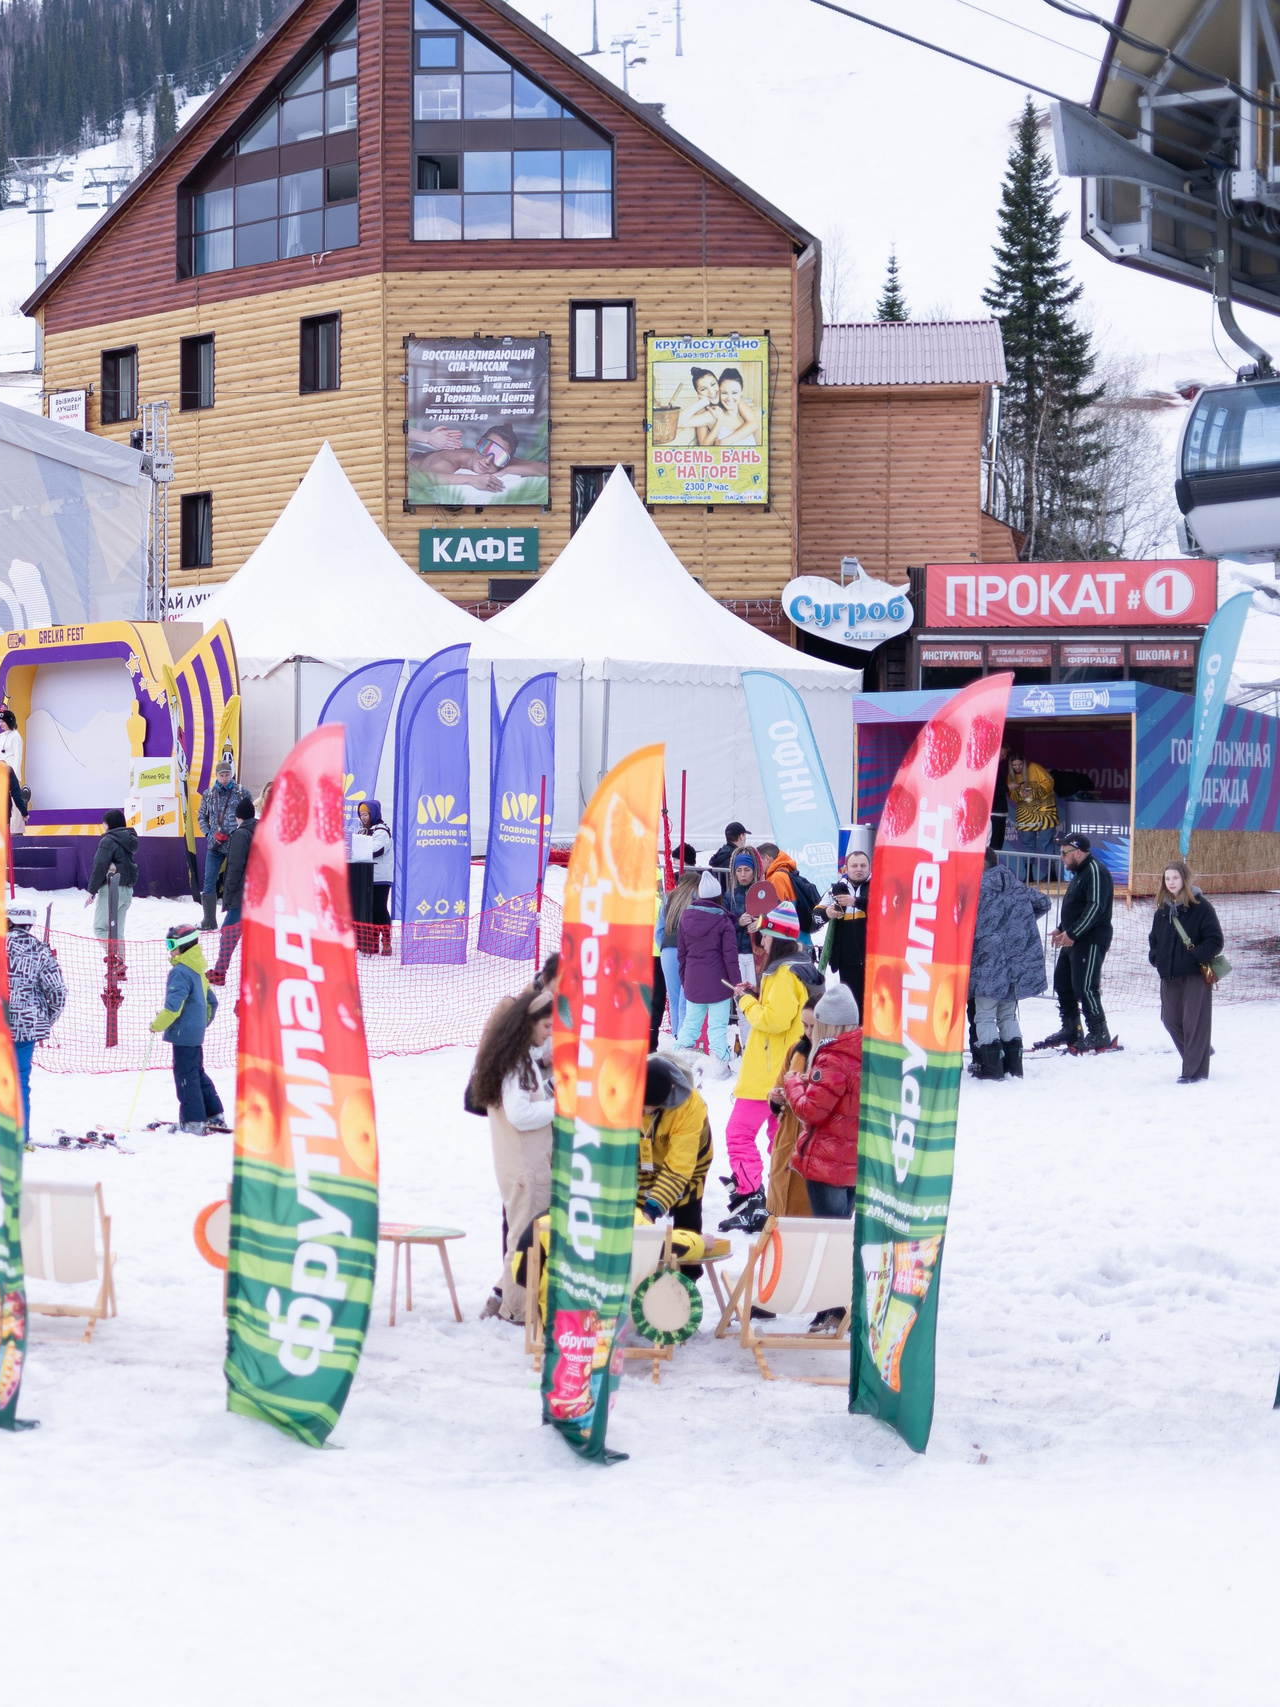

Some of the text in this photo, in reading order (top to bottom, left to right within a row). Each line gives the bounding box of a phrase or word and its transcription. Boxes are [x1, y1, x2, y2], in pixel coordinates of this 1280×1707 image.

[655, 340, 759, 349] КРУГЛОСУТОЧНО
[422, 347, 535, 360] ВОССТАНАВЛИВАЮЩИЙ
[448, 361, 508, 372] СПА-МАССАЖ
[422, 384, 481, 393] Восстановись
[503, 381, 531, 389] склоне?
[55, 394, 82, 405] ВЫБИРАЙ
[443, 393, 499, 403] Термальном
[501, 393, 535, 403] Центре
[56, 403, 80, 413] ЛУЧШЕЕ!
[654, 450, 761, 463] ВОСЕМЬ БАНЬ
[677, 466, 737, 478] НА ГОРЕ
[685, 483, 705, 491] 2300
[432, 536, 525, 562] КАФЕ
[945, 573, 1126, 617] ПРОКАТ
[790, 595, 905, 628] Сугроб
[38, 627, 84, 644] GRELKA FEST
[922, 651, 982, 660] ИНСТРУКТОРЫ
[991, 648, 1015, 656] ДЕТСКИЙ
[1136, 650, 1171, 660] ШКОЛА
[1067, 656, 1118, 664] ФРИРАЙД
[1171, 738, 1271, 768] ГОРЛЫЖНАЯ
[157, 816, 165, 825] 16
[416, 828, 457, 837] Главные
[499, 823, 538, 836] Главные
[1071, 824, 1131, 835] ШЕРЕГЕШ
[416, 838, 457, 847] красоте
[499, 833, 536, 845] красоте
[264, 900, 352, 1378] фрутилад
